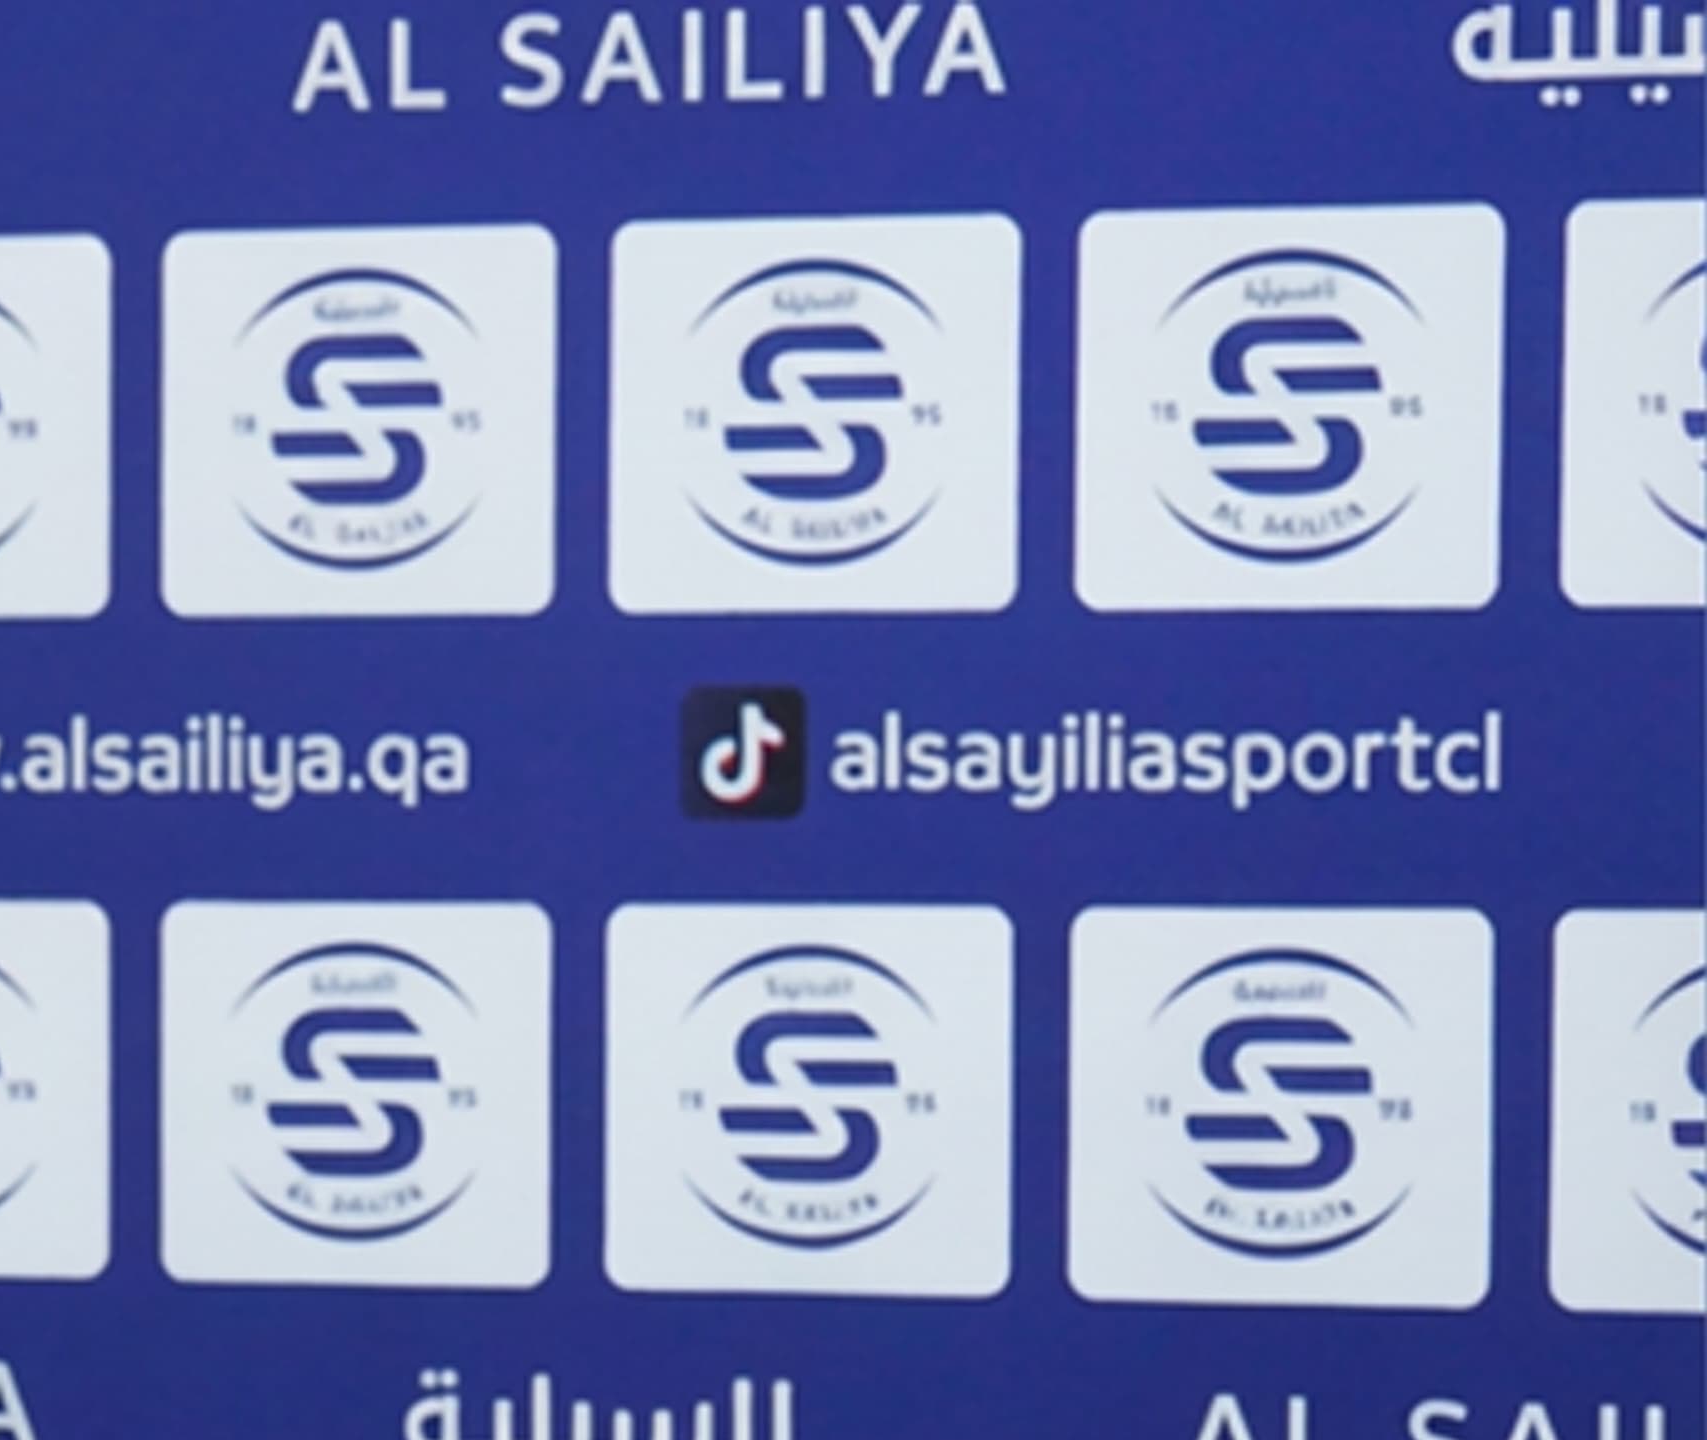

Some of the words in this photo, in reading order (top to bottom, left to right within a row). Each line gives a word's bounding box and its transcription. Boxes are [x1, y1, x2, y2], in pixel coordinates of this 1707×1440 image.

[292, 18, 447, 113] AL
[500, 1, 1006, 108] SAILIYA
[830, 710, 1501, 811] alsayiliasportcl
